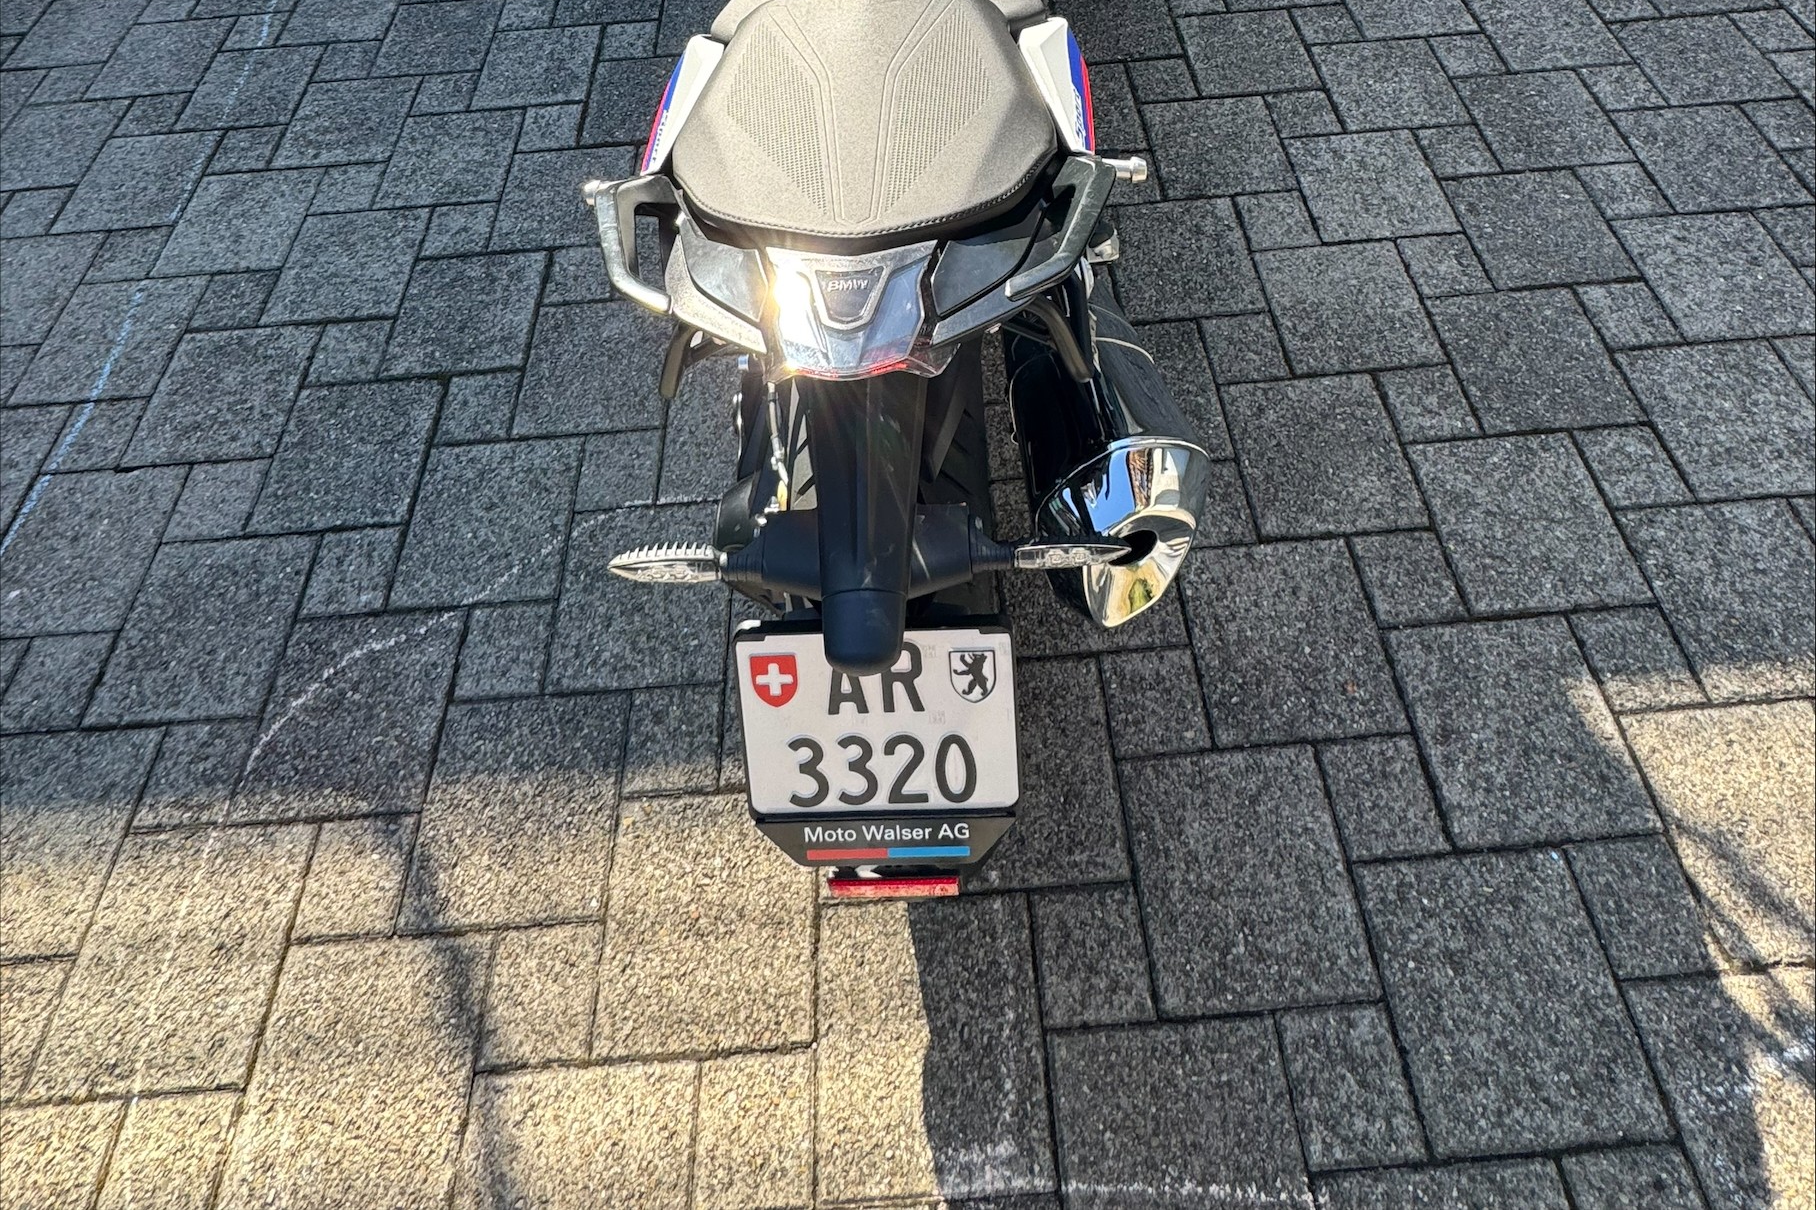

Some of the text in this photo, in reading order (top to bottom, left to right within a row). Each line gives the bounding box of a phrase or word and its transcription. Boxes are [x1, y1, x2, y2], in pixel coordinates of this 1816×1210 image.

[827, 278, 868, 292] BMW
[828, 640, 925, 715] AR
[788, 733, 977, 807] 3320
[804, 823, 970, 842] Moto Walser AG
